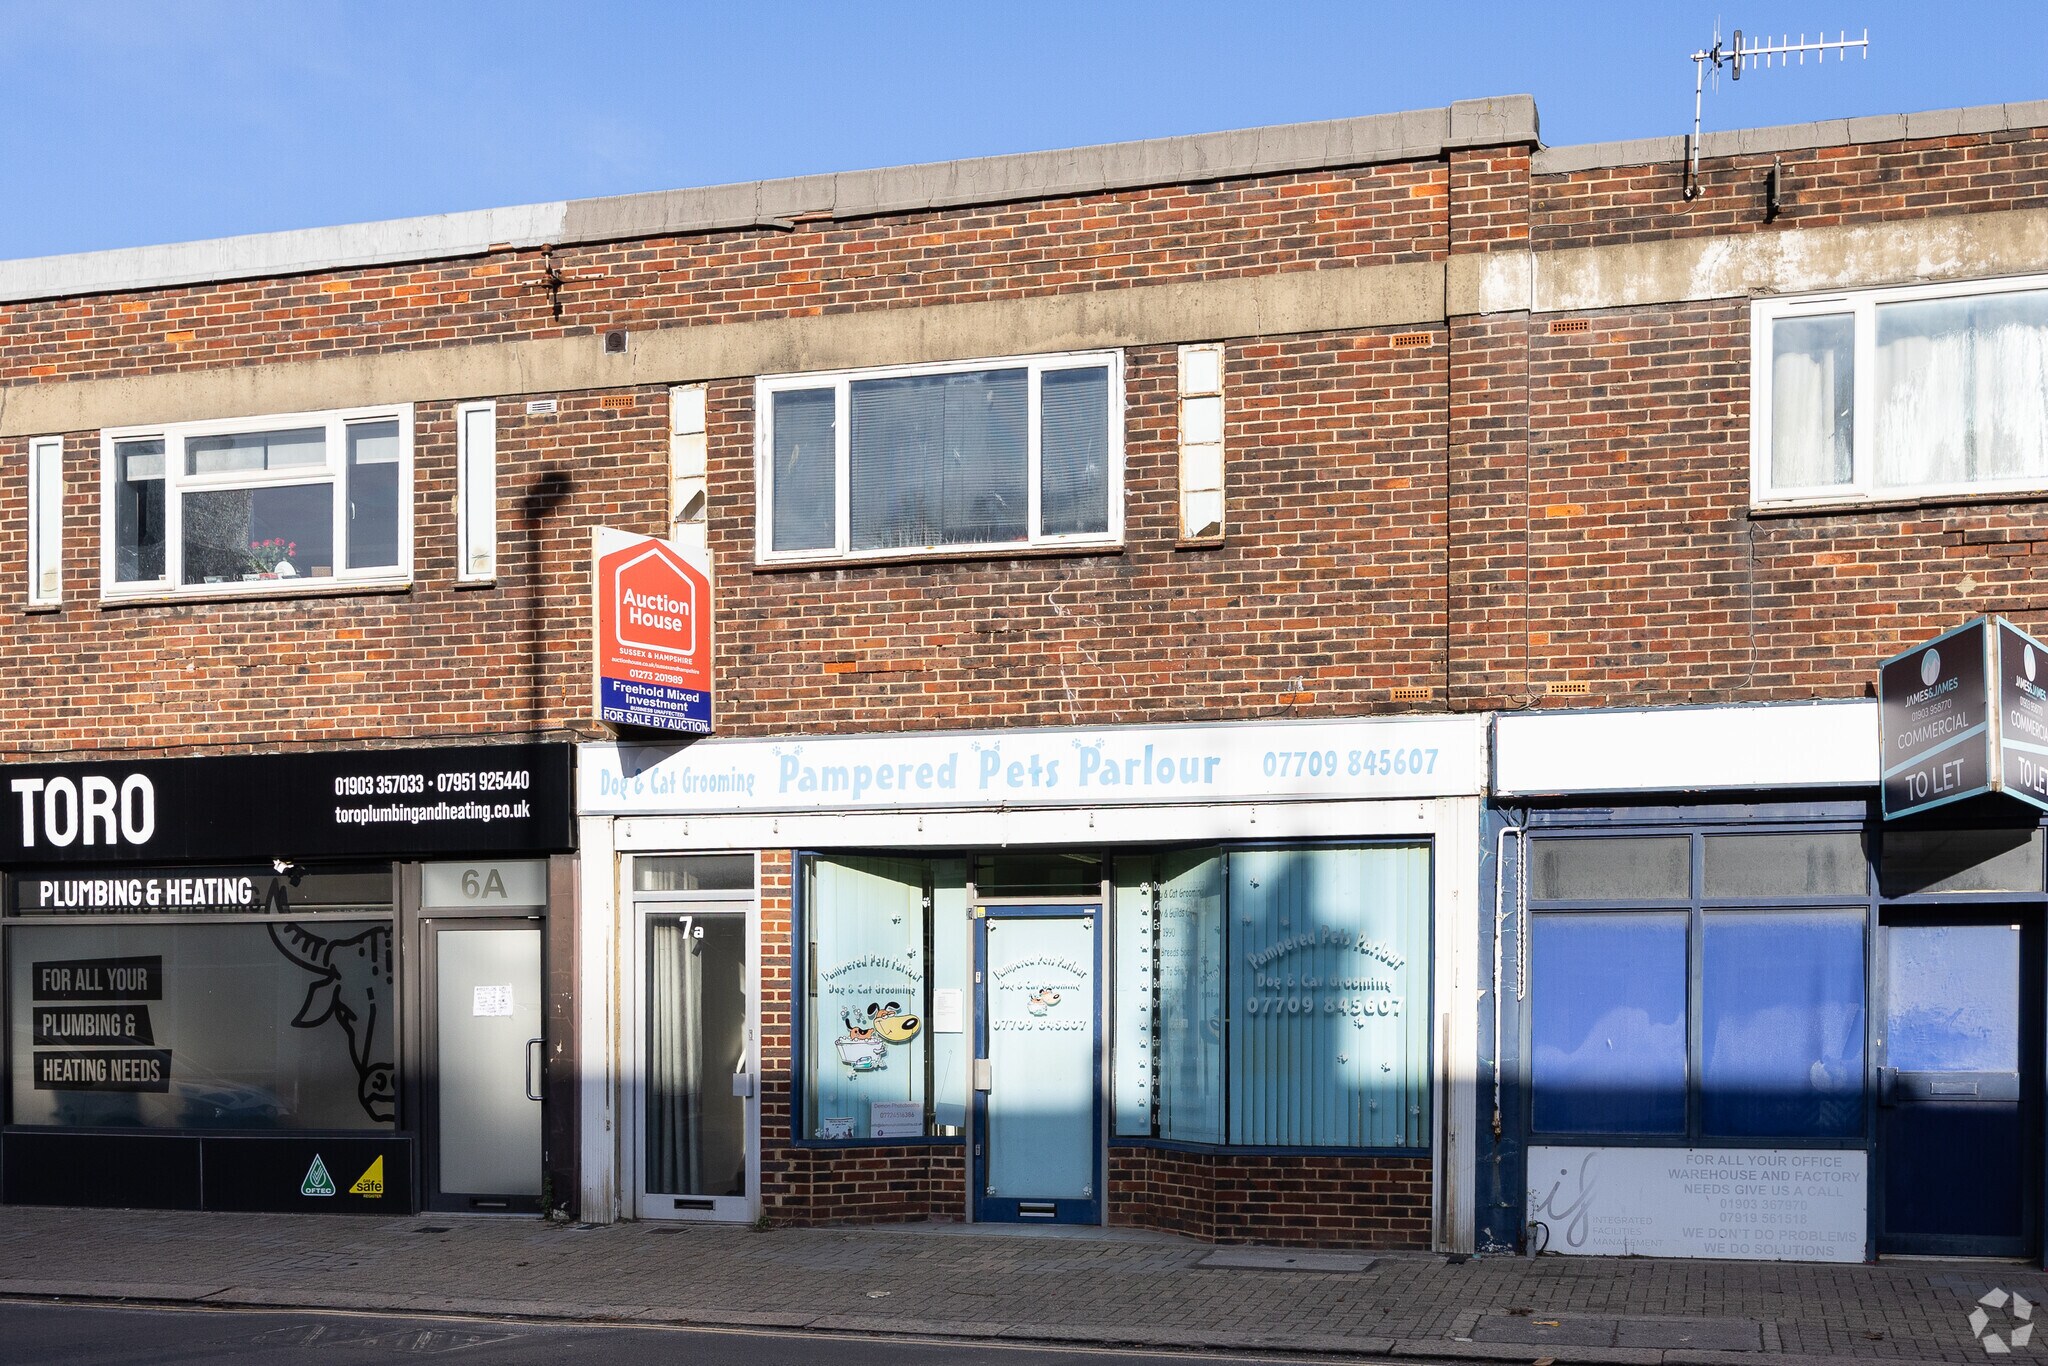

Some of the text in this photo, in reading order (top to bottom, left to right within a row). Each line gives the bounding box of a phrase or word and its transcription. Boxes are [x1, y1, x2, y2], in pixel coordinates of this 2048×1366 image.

[623, 588, 689, 616] Auction
[629, 607, 683, 632] House
[619, 647, 646, 658] SUSSEX
[654, 652, 693, 665] HAMPSHIRE
[629, 669, 684, 685] 01273 201989
[613, 681, 700, 703] Freehold Mixed
[625, 694, 688, 712] Investment
[604, 710, 708, 732] FOR SALE BY AUCTION
[1898, 711, 1969, 750] COMMERCIAL
[779, 744, 1220, 800] Pampered Pets Parlour
[1263, 748, 1439, 777] 07709 845607
[2018, 756, 2032, 787] TO
[335, 770, 530, 795] 01903 357033 07951 925440
[600, 766, 755, 800] Dog & Cat Grooming
[1905, 758, 1964, 801] TO LET
[11, 774, 155, 848] TORO
[335, 799, 530, 826] toroplumbingandheating.co.uk
[40, 877, 252, 907] PLUMBING & HEATING
[461, 868, 508, 899] 6A
[679, 916, 704, 940] 7a
[1247, 925, 1406, 971] Pampered Pets Parlour
[42, 968, 147, 991] FOR ALL YOUR
[1257, 972, 1281, 990] Dog
[1301, 973, 1322, 988] Cat
[1329, 975, 1392, 993] Grooming
[1247, 996, 1404, 1018] 07709 845607
[43, 1013, 136, 1036] PLUMBING &
[43, 1058, 160, 1081] HEATING NEEDS
[1686, 1154, 1842, 1168] FOR ALL YOUR OFFICE
[356, 1181, 382, 1192] safe
[1668, 1169, 1860, 1182] WAREHOUSE AND FACTORY
[1684, 1183, 1844, 1197] NEEDS GIVE US A CALL
[1720, 1199, 1757, 1210] 01903
[1592, 1216, 1653, 1225] INTEGRATED
[1719, 1212, 1808, 1225] 07919 561518
[1592, 1227, 1642, 1236] FACILITIES
[1592, 1238, 1664, 1247] MANAGEMENT
[1682, 1227, 1857, 1242] WE DON'T DO PROBLEMS
[1704, 1242, 1835, 1257] WE DO SOLUTIONS
